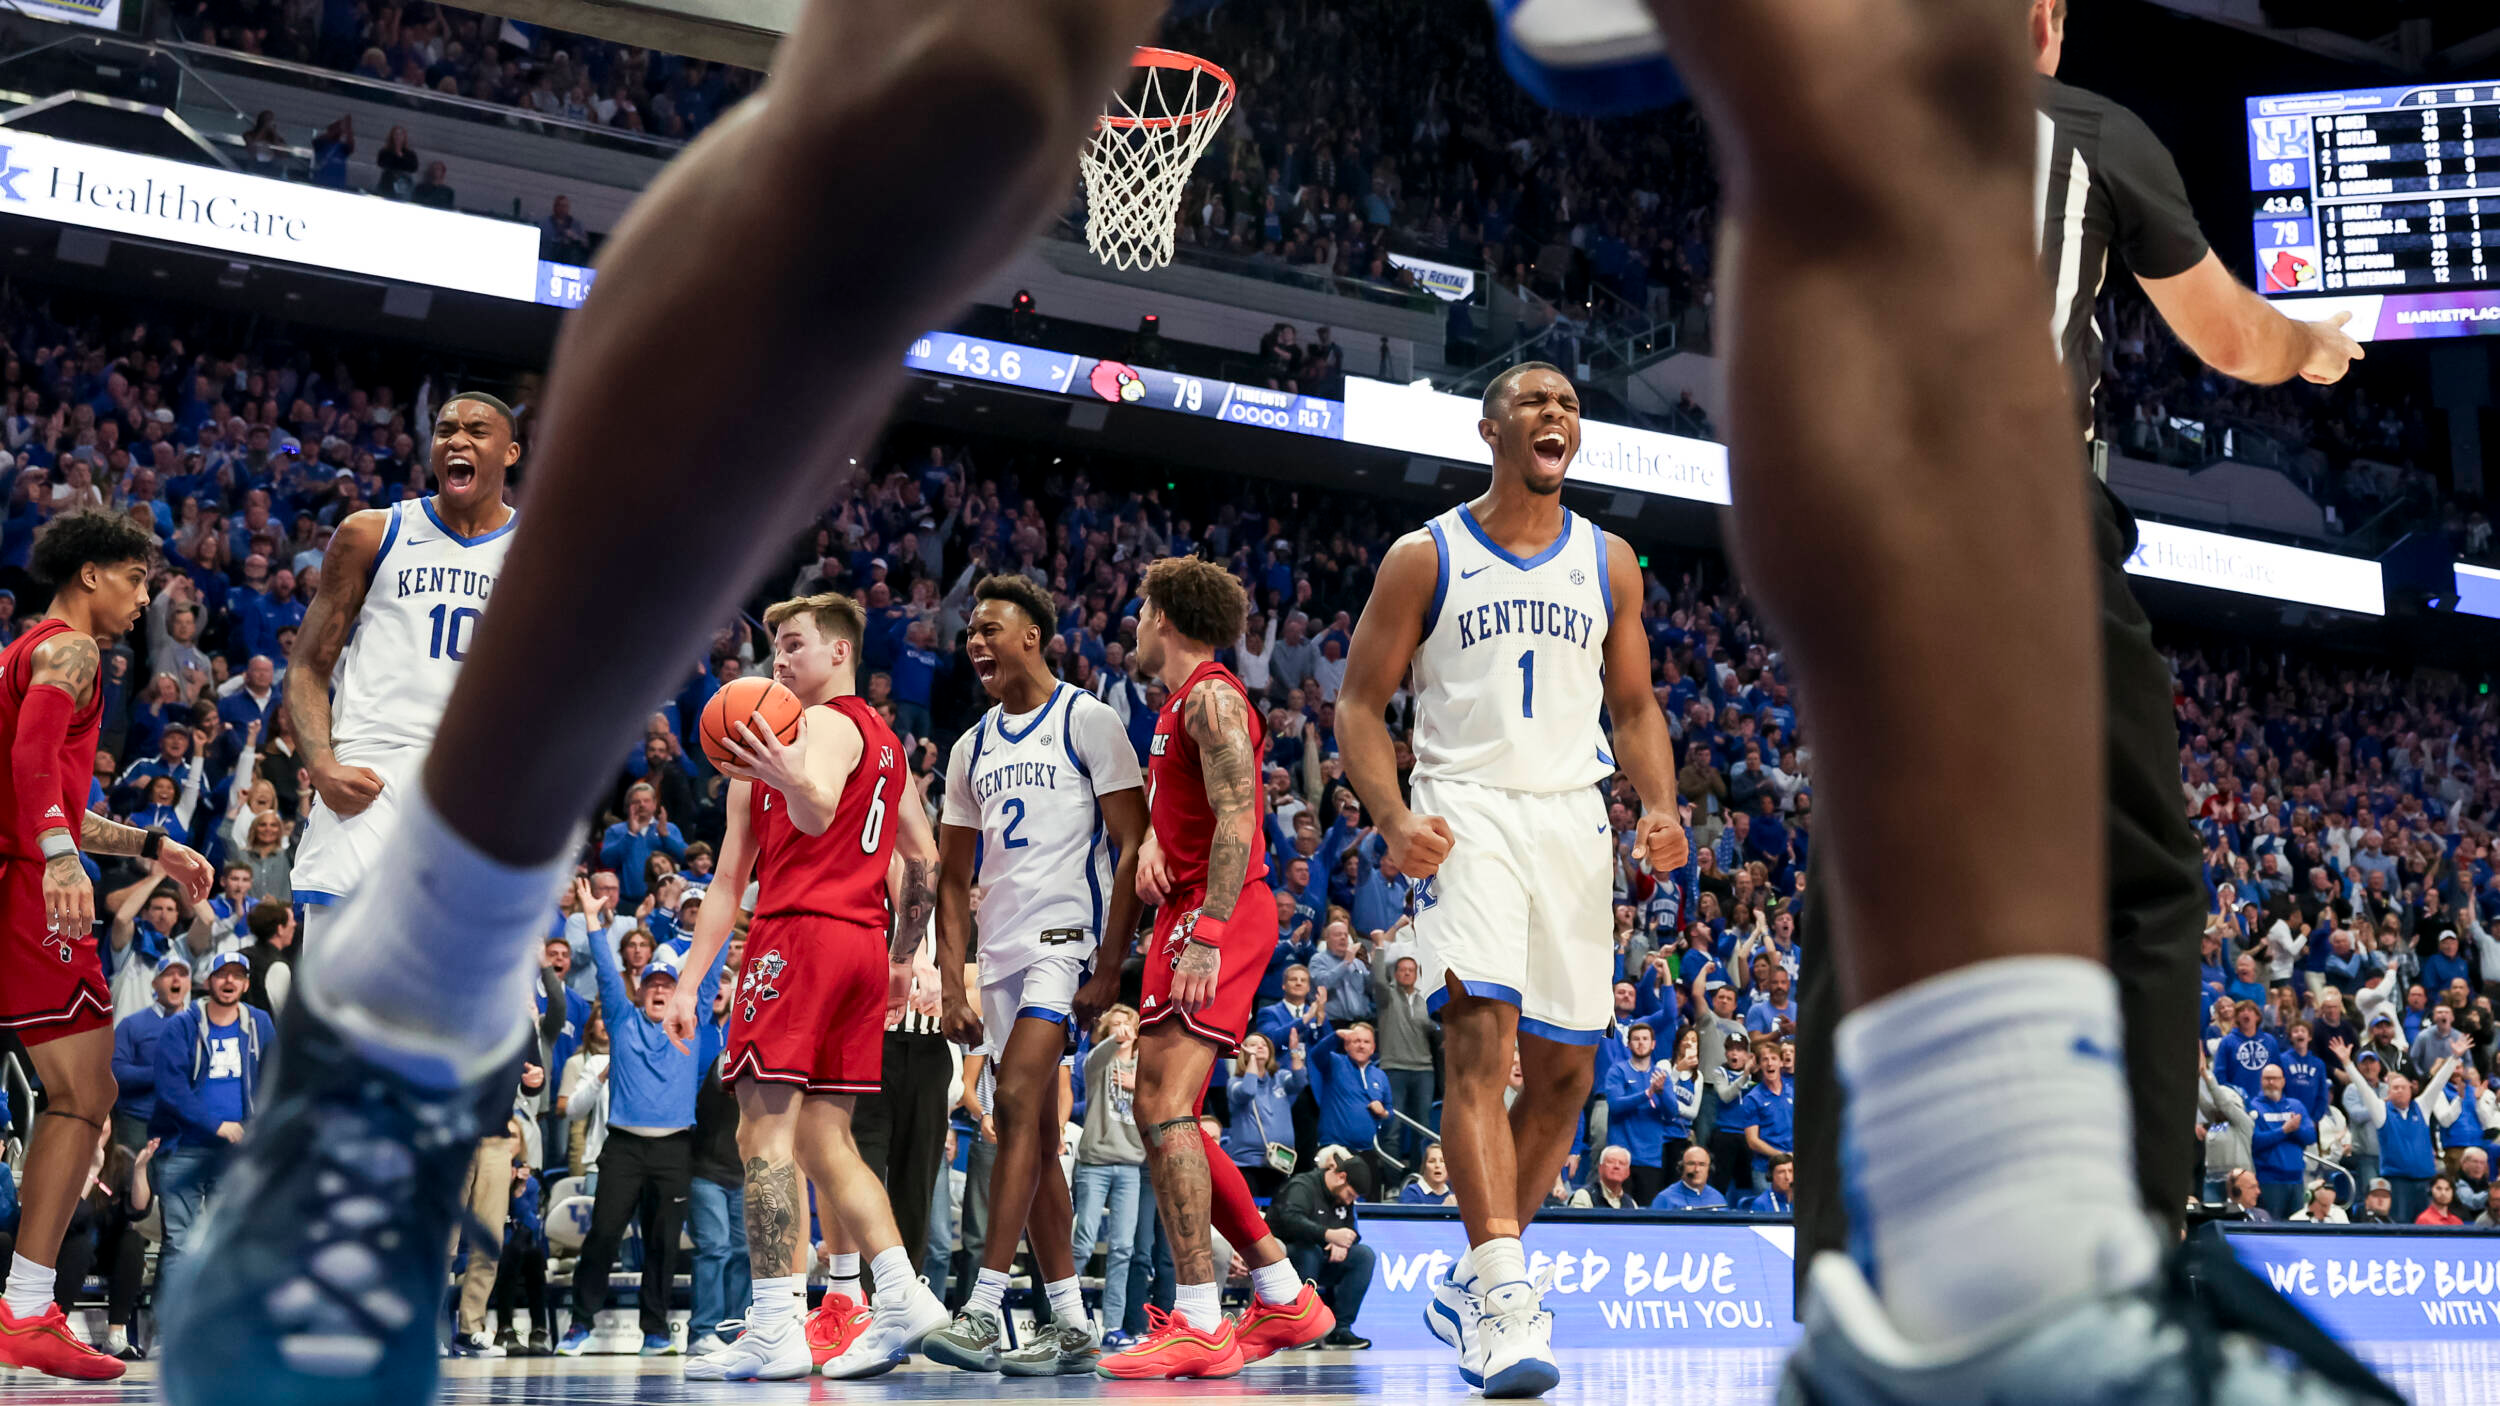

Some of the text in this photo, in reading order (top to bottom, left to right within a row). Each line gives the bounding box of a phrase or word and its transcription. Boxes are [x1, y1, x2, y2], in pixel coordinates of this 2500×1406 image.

[2463, 108, 2471, 122] 1
[2322, 133, 2330, 147] 1
[2322, 149, 2331, 164] 2
[2424, 142, 2440, 157] 12
[2268, 162, 2296, 187] 86
[2323, 166, 2331, 180] 7
[50, 166, 307, 241] HealthCare
[2262, 195, 2305, 214] 43.6
[2327, 207, 2335, 221] 1
[2272, 221, 2299, 245] 79
[2429, 216, 2445, 232] 21
[2471, 214, 2479, 229] 1
[2325, 256, 2342, 271] 24
[2431, 250, 2448, 266] 22
[2433, 267, 2449, 282] 12
[2472, 265, 2487, 281] 11
[550, 277, 563, 298] 9
[905, 338, 1021, 381] ND 43.6
[1172, 376, 1203, 412] 79
[1235, 386, 1288, 408] TIMEOUTS
[1298, 409, 1331, 429] FLS 7
[2157, 541, 2275, 584] HealthCare
[397, 566, 498, 601] KENTUC
[429, 603, 484, 662] 10
[1457, 598, 1593, 650] KENTUCKY
[1518, 649, 1535, 719] 1
[976, 761, 1057, 805] KENTUCKY
[860, 775, 887, 855] 6
[1001, 797, 1029, 850] 2
[1381, 1248, 1454, 1297] WE
[1624, 1250, 1737, 1297] BLUE
[2264, 1257, 2500, 1299] WE BLEED BLU
[1598, 1299, 1774, 1330] WITH YOU.
[2420, 1300, 2488, 1326] WITH
